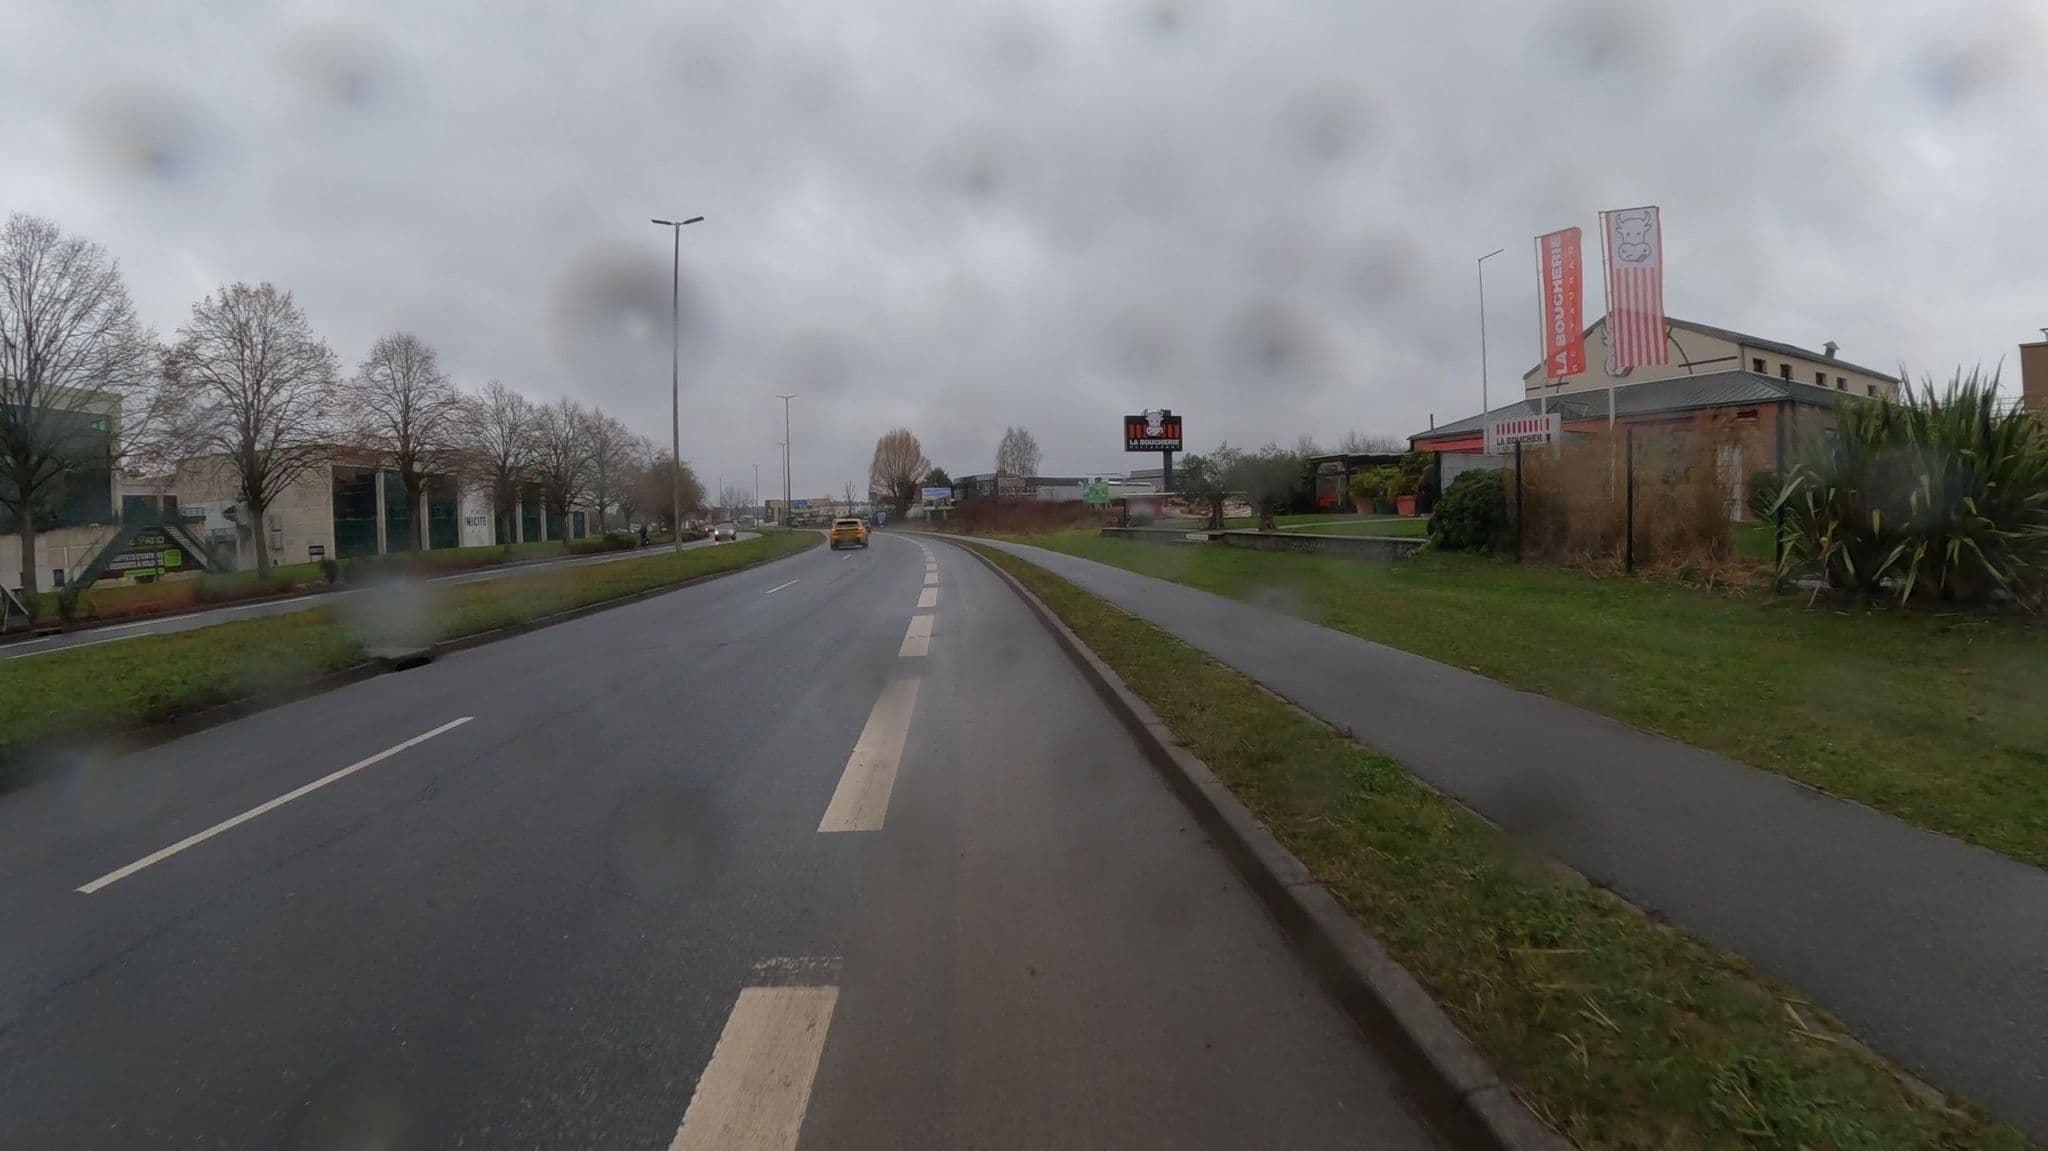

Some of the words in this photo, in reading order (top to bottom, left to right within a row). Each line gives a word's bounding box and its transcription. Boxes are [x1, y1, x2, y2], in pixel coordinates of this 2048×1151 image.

[1567, 245, 1579, 373] RESTAURAN
[1556, 351, 1568, 375] LA
[1140, 438, 1180, 446] BOUCHERIE
[1496, 437, 1505, 446] LA
